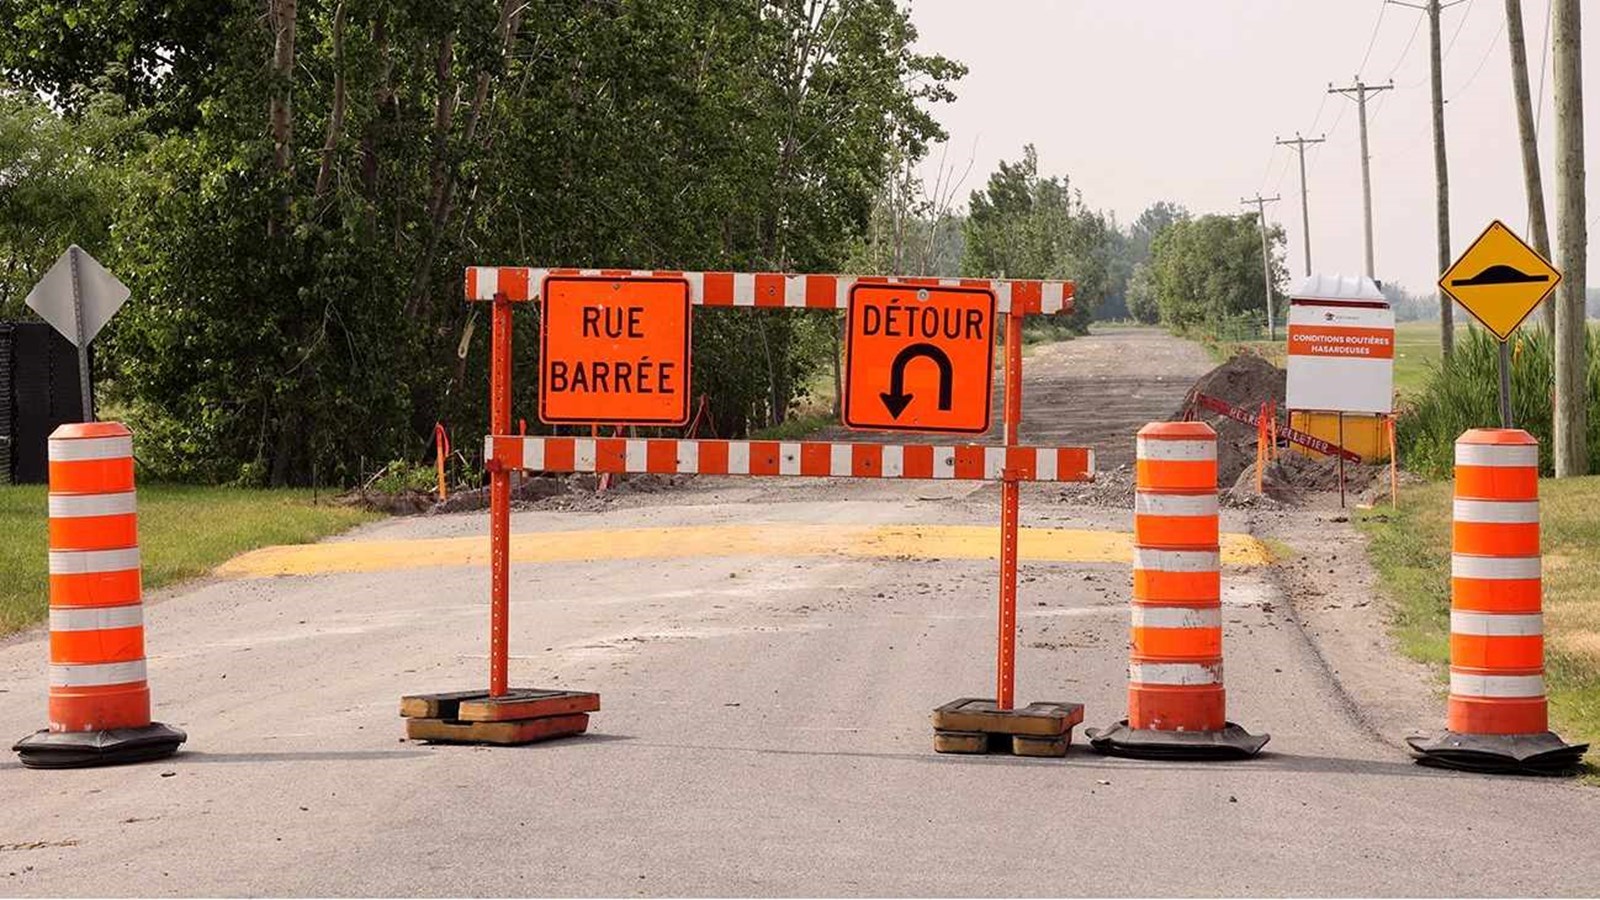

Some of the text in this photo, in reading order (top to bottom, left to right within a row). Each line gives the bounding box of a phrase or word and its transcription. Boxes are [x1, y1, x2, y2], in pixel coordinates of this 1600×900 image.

[582, 306, 644, 338] RUE
[863, 298, 984, 340] DÉTOUR
[1293, 334, 1390, 345] CONDITIONS ROUTIÈRES
[1311, 345, 1370, 355] HASARDEUSES
[550, 355, 675, 394] BARRÉE
